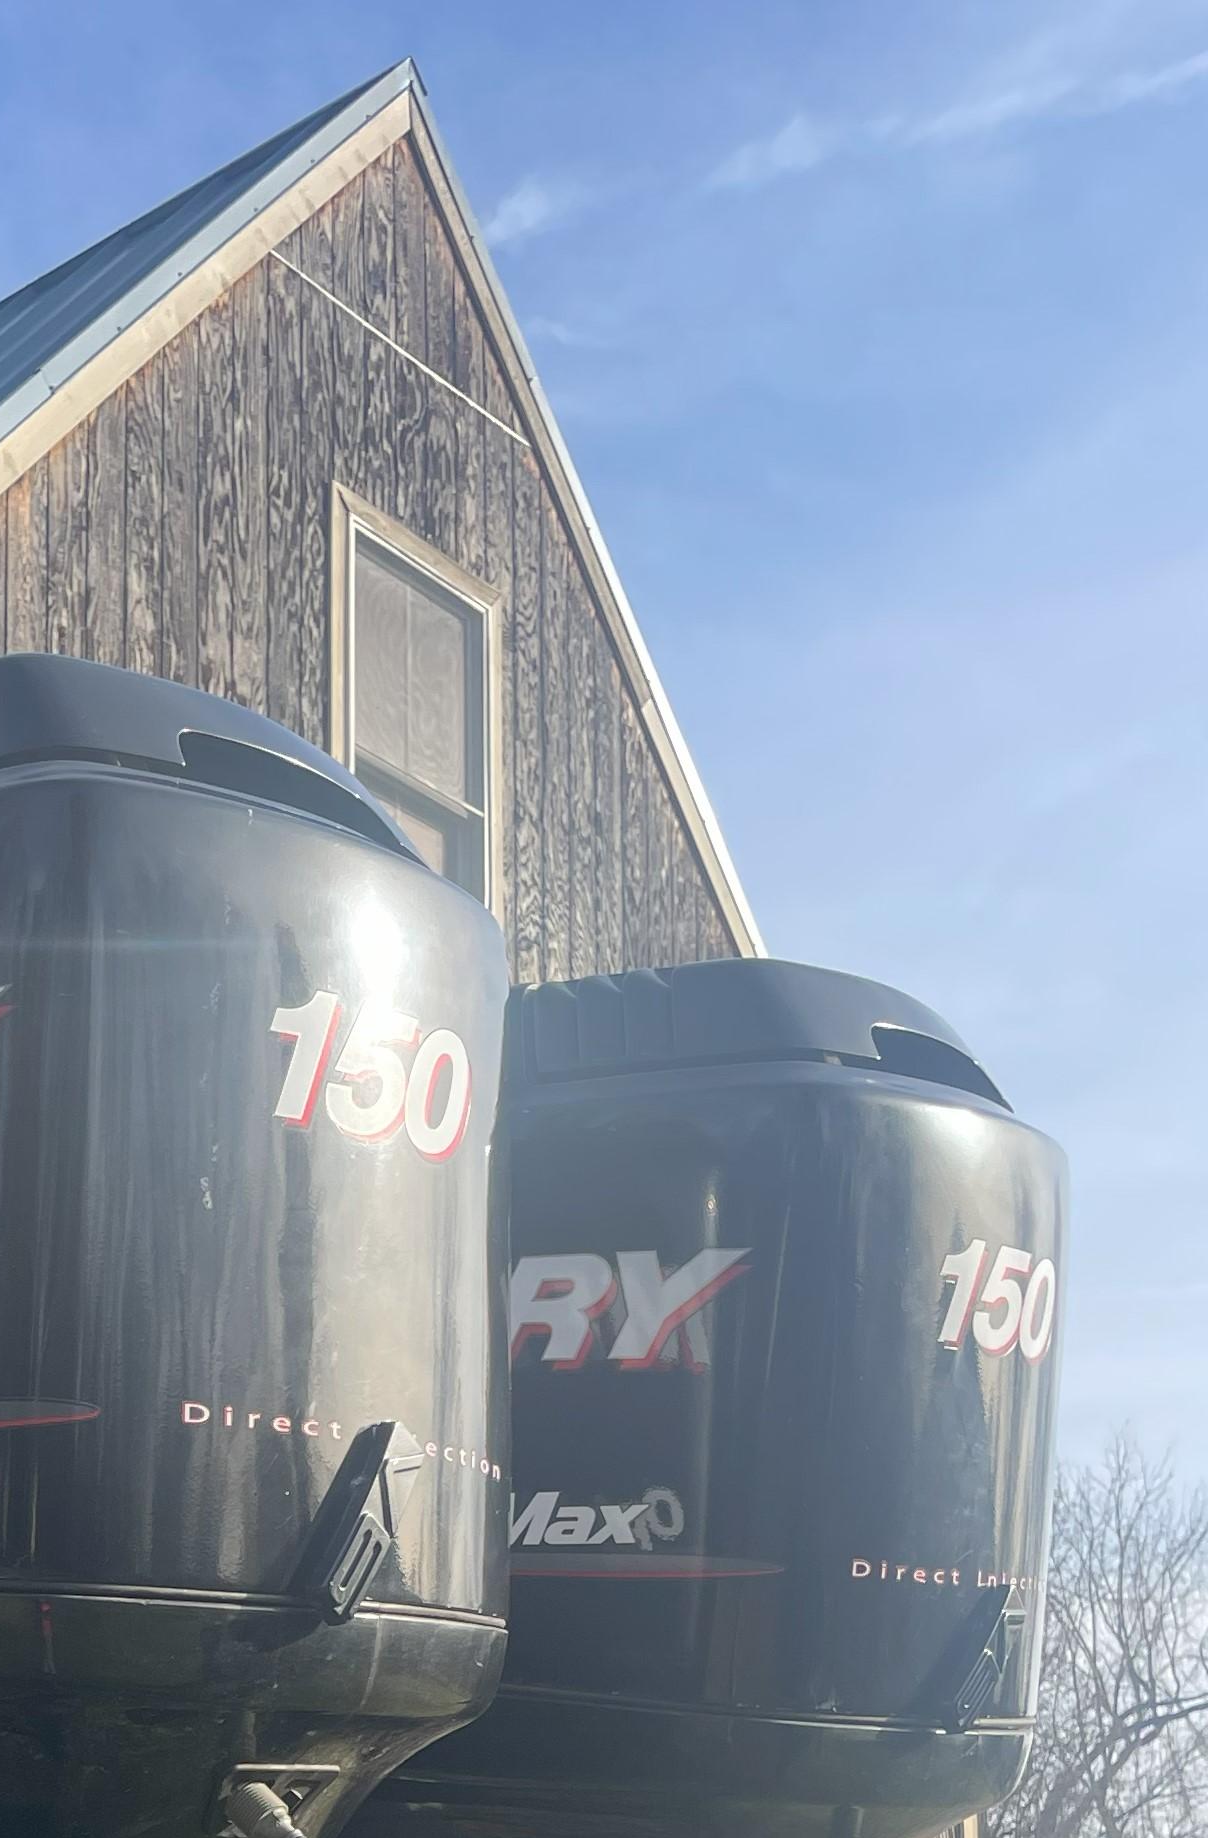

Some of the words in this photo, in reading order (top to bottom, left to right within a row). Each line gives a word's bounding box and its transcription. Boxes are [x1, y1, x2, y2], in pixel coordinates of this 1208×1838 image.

[269, 989, 473, 1164] 150
[509, 1246, 753, 1371] RY
[936, 1238, 1056, 1366] 150
[181, 1400, 342, 1441] Direct
[422, 1434, 502, 1482] ection
[509, 1490, 650, 1547] Max
[851, 1558, 961, 1586] Direct
